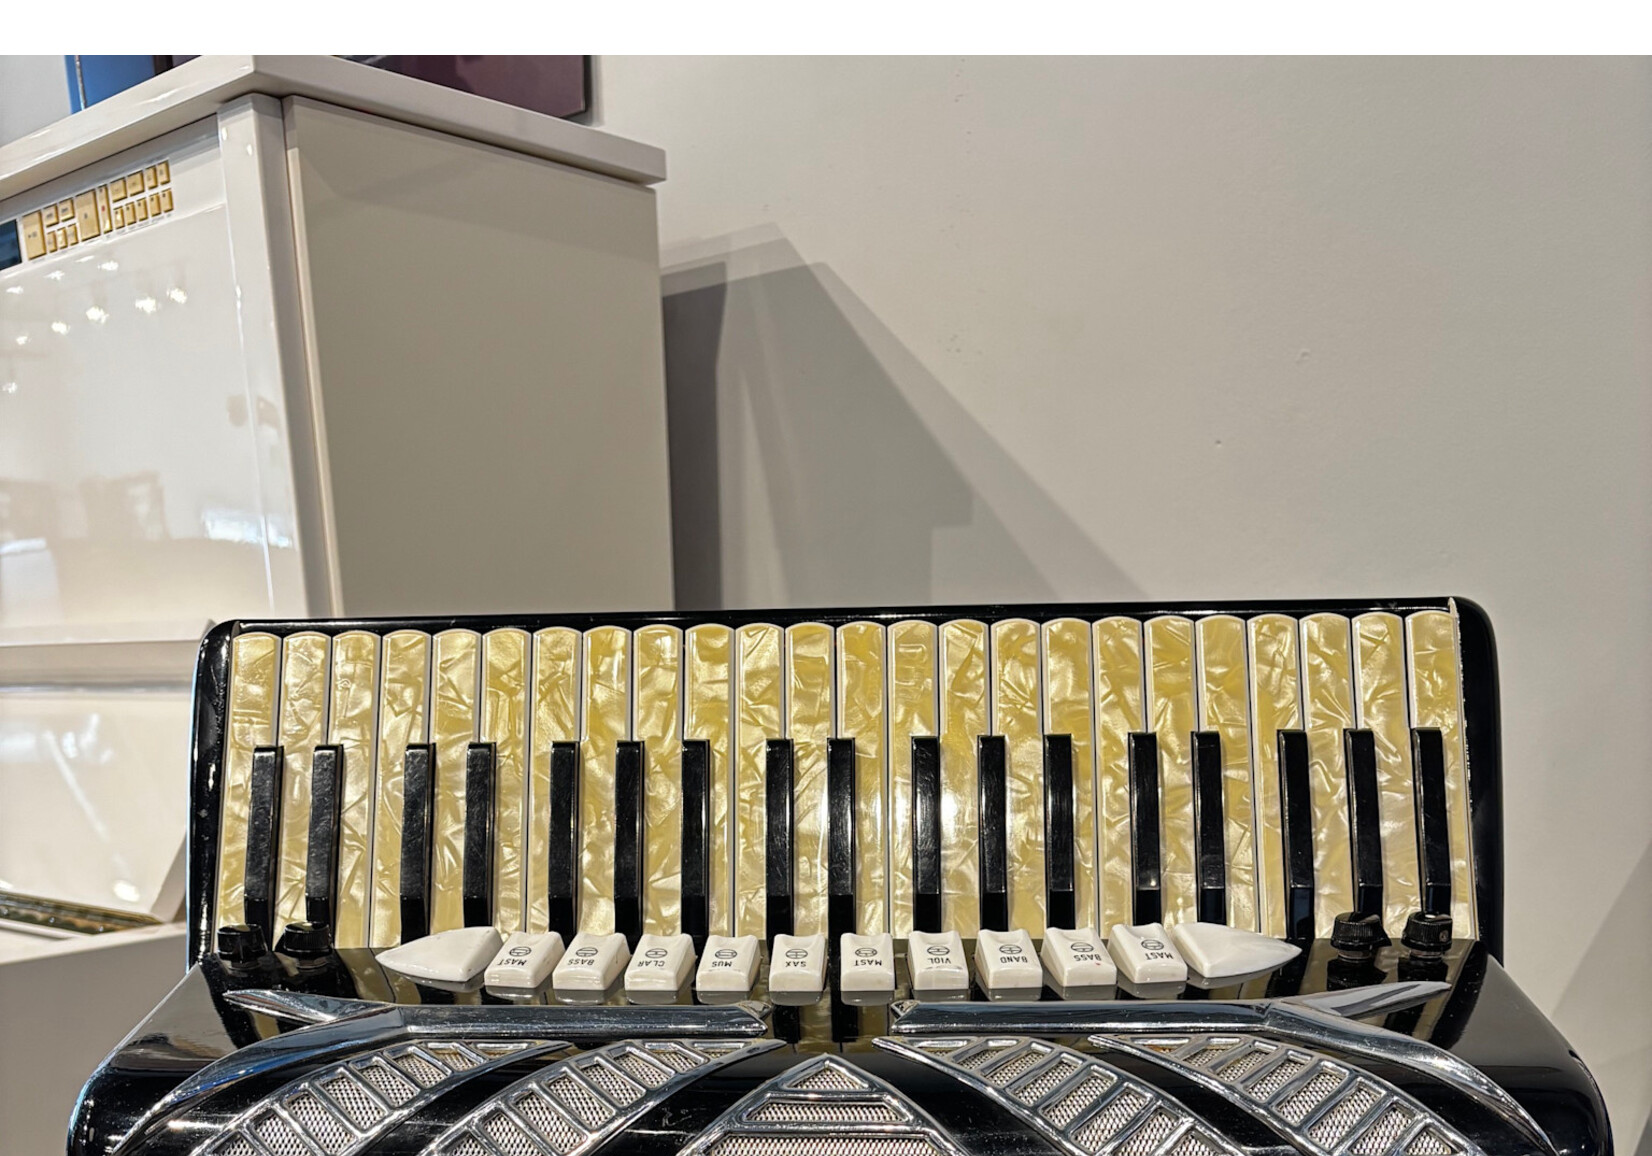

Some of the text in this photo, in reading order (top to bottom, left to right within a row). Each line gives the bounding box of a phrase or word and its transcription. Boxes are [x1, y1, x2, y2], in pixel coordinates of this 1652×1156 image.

[1000, 955, 1028, 964] BAND
[1073, 953, 1102, 962] BASS
[1145, 951, 1174, 961] MAST
[498, 958, 527, 966] MAST
[567, 958, 595, 966] BASS
[711, 960, 733, 968] MUS
[854, 959, 883, 967] MAST
